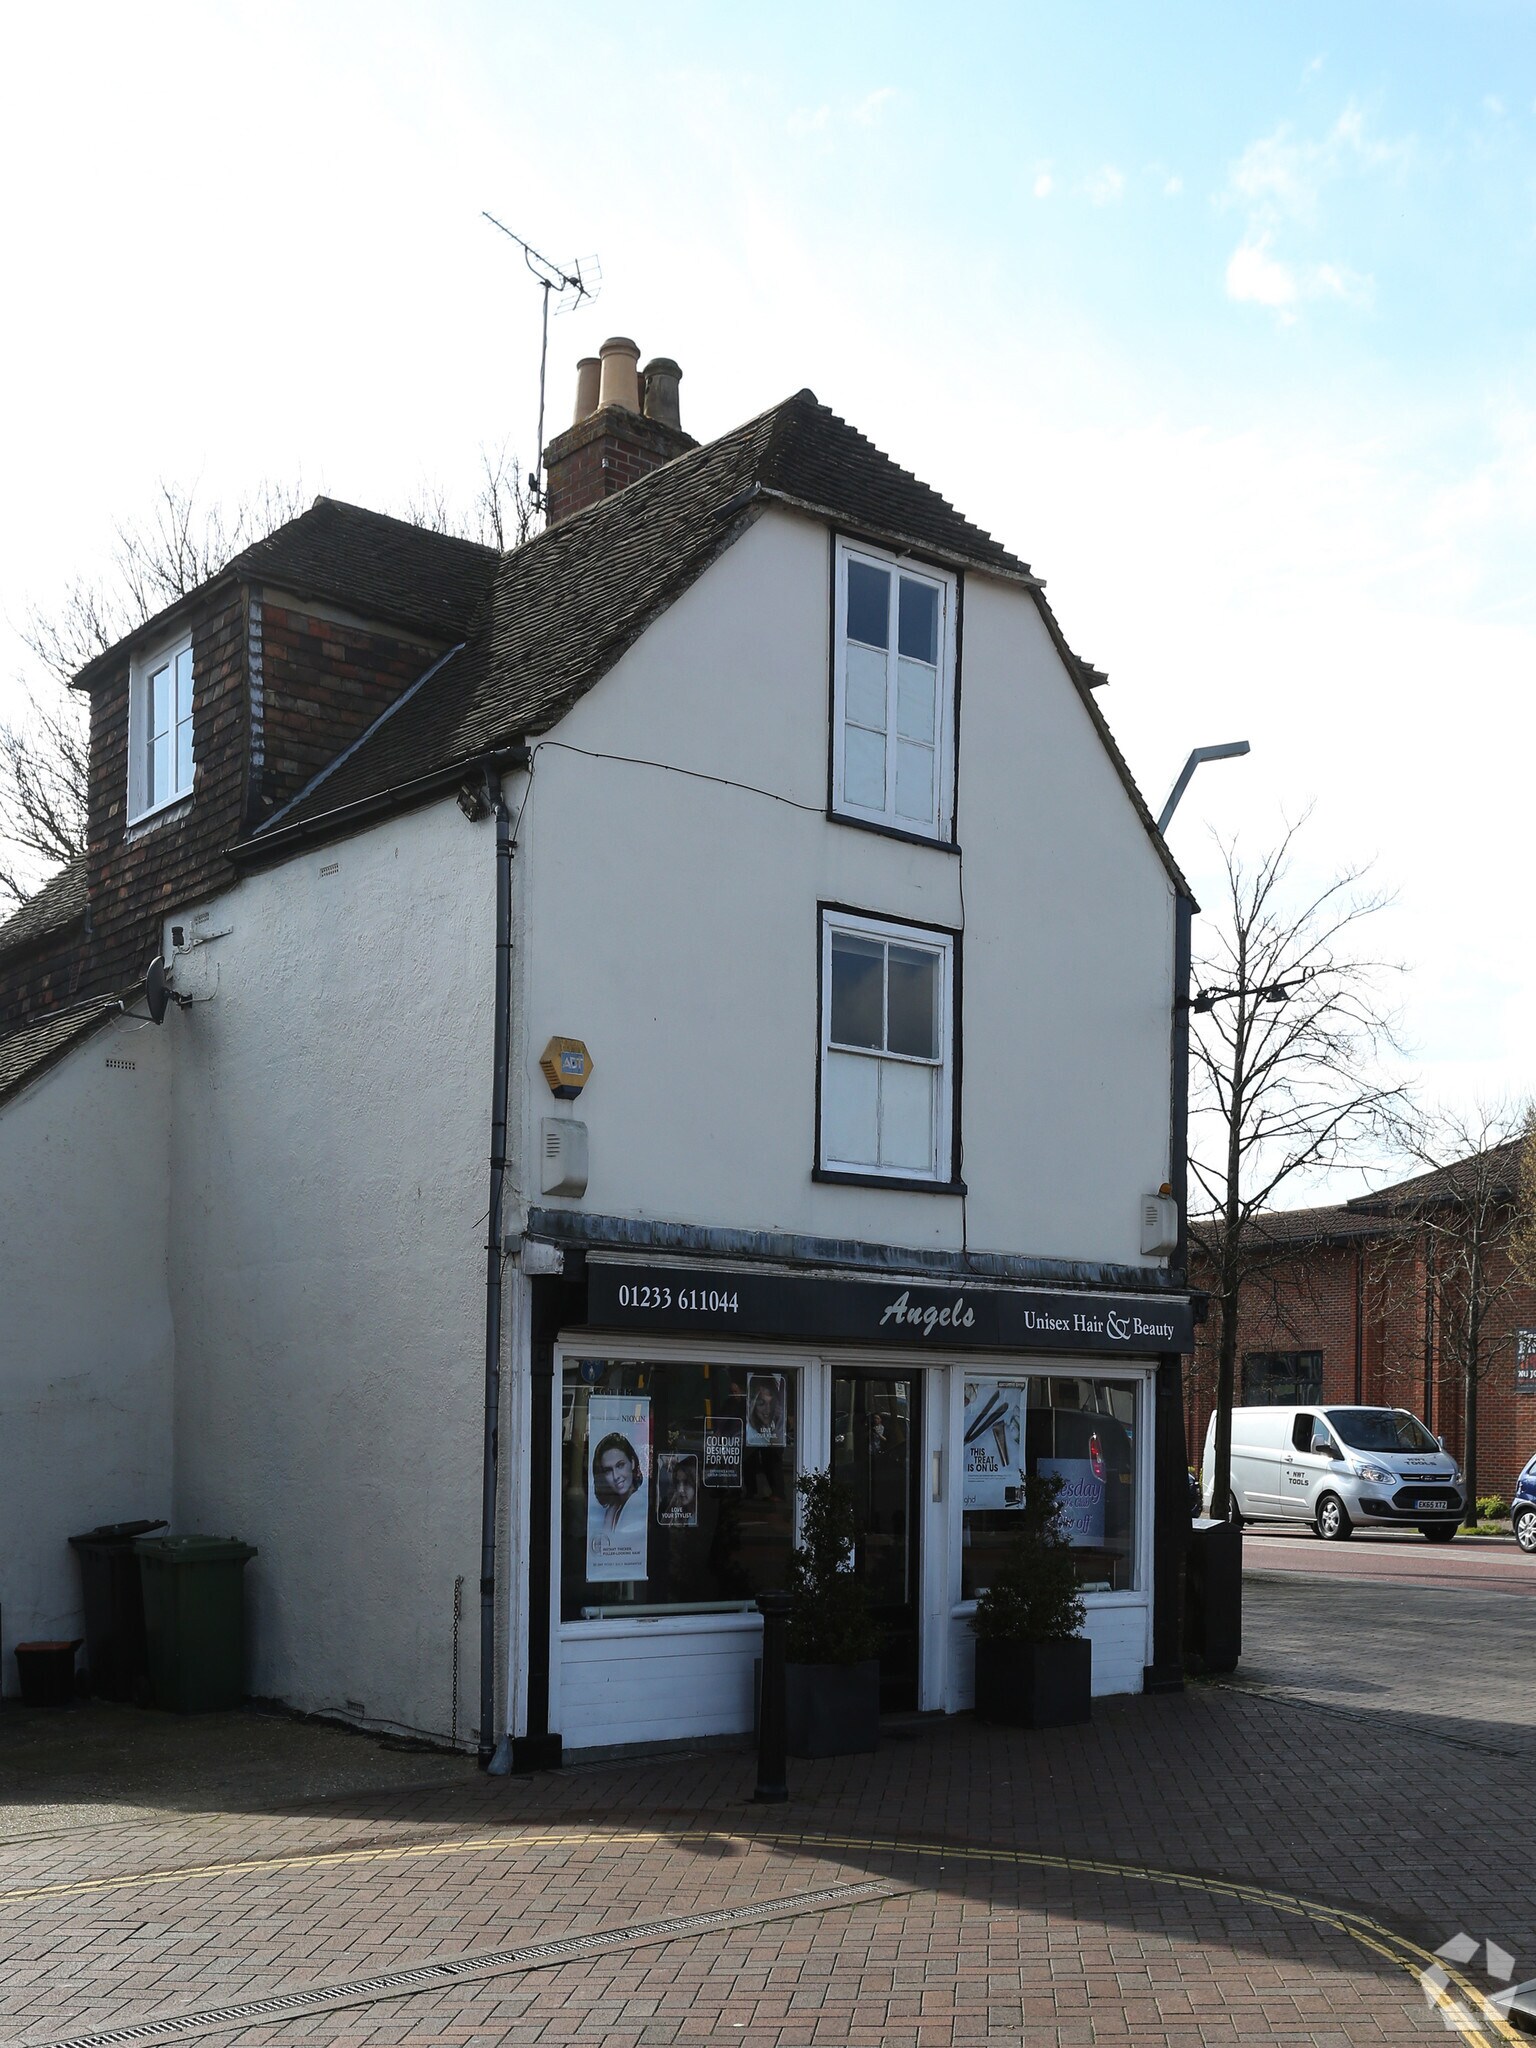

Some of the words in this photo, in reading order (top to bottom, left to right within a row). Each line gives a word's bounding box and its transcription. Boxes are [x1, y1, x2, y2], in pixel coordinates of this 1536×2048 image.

[562, 1057, 583, 1070] ADT
[618, 1285, 672, 1310] 01233
[677, 1290, 739, 1313] 611044
[879, 1291, 976, 1337] Angels
[1024, 1310, 1070, 1332] Unisex
[1073, 1314, 1104, 1334] Hair
[1106, 1310, 1131, 1340] &
[1133, 1320, 1174, 1340] Beauty
[706, 1436, 740, 1447] COLOUR
[706, 1446, 740, 1455] DESIGNED
[970, 1448, 985, 1456] THIS
[706, 1455, 721, 1465] FOR
[723, 1455, 740, 1465] YOU
[967, 1464, 975, 1472] IS
[976, 1464, 987, 1472] ON
[989, 1464, 999, 1472] US
[1288, 1478, 1309, 1486] TOOLS
